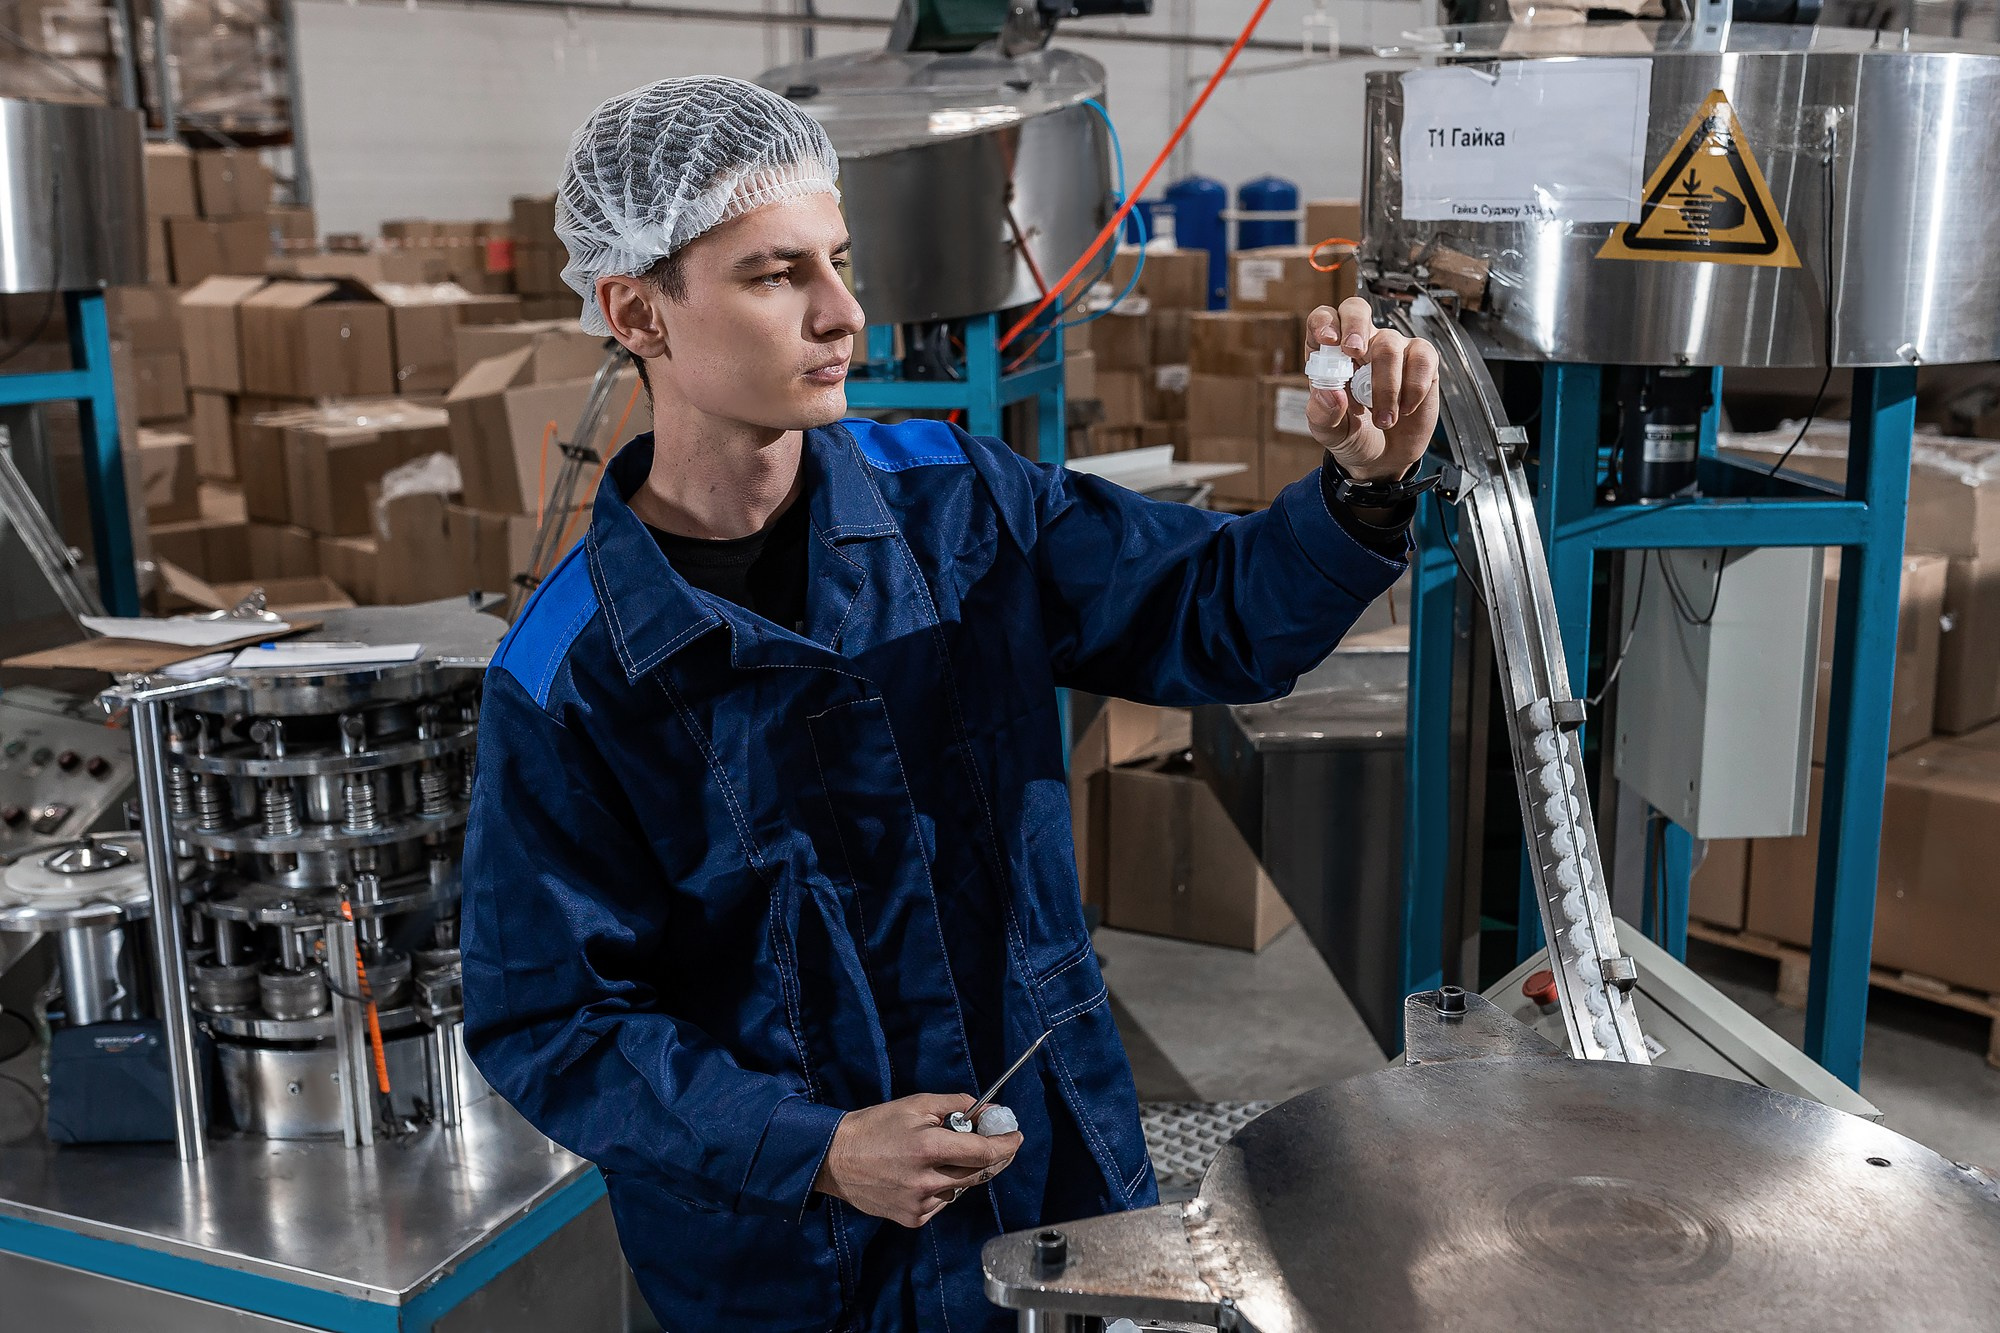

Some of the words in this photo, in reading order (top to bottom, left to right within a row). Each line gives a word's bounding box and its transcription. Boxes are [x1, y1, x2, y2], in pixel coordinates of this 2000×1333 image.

[1452, 127, 1505, 147] Гайка
[1452, 204, 1478, 215] Гайка
[1481, 204, 1521, 217] Суджоу
